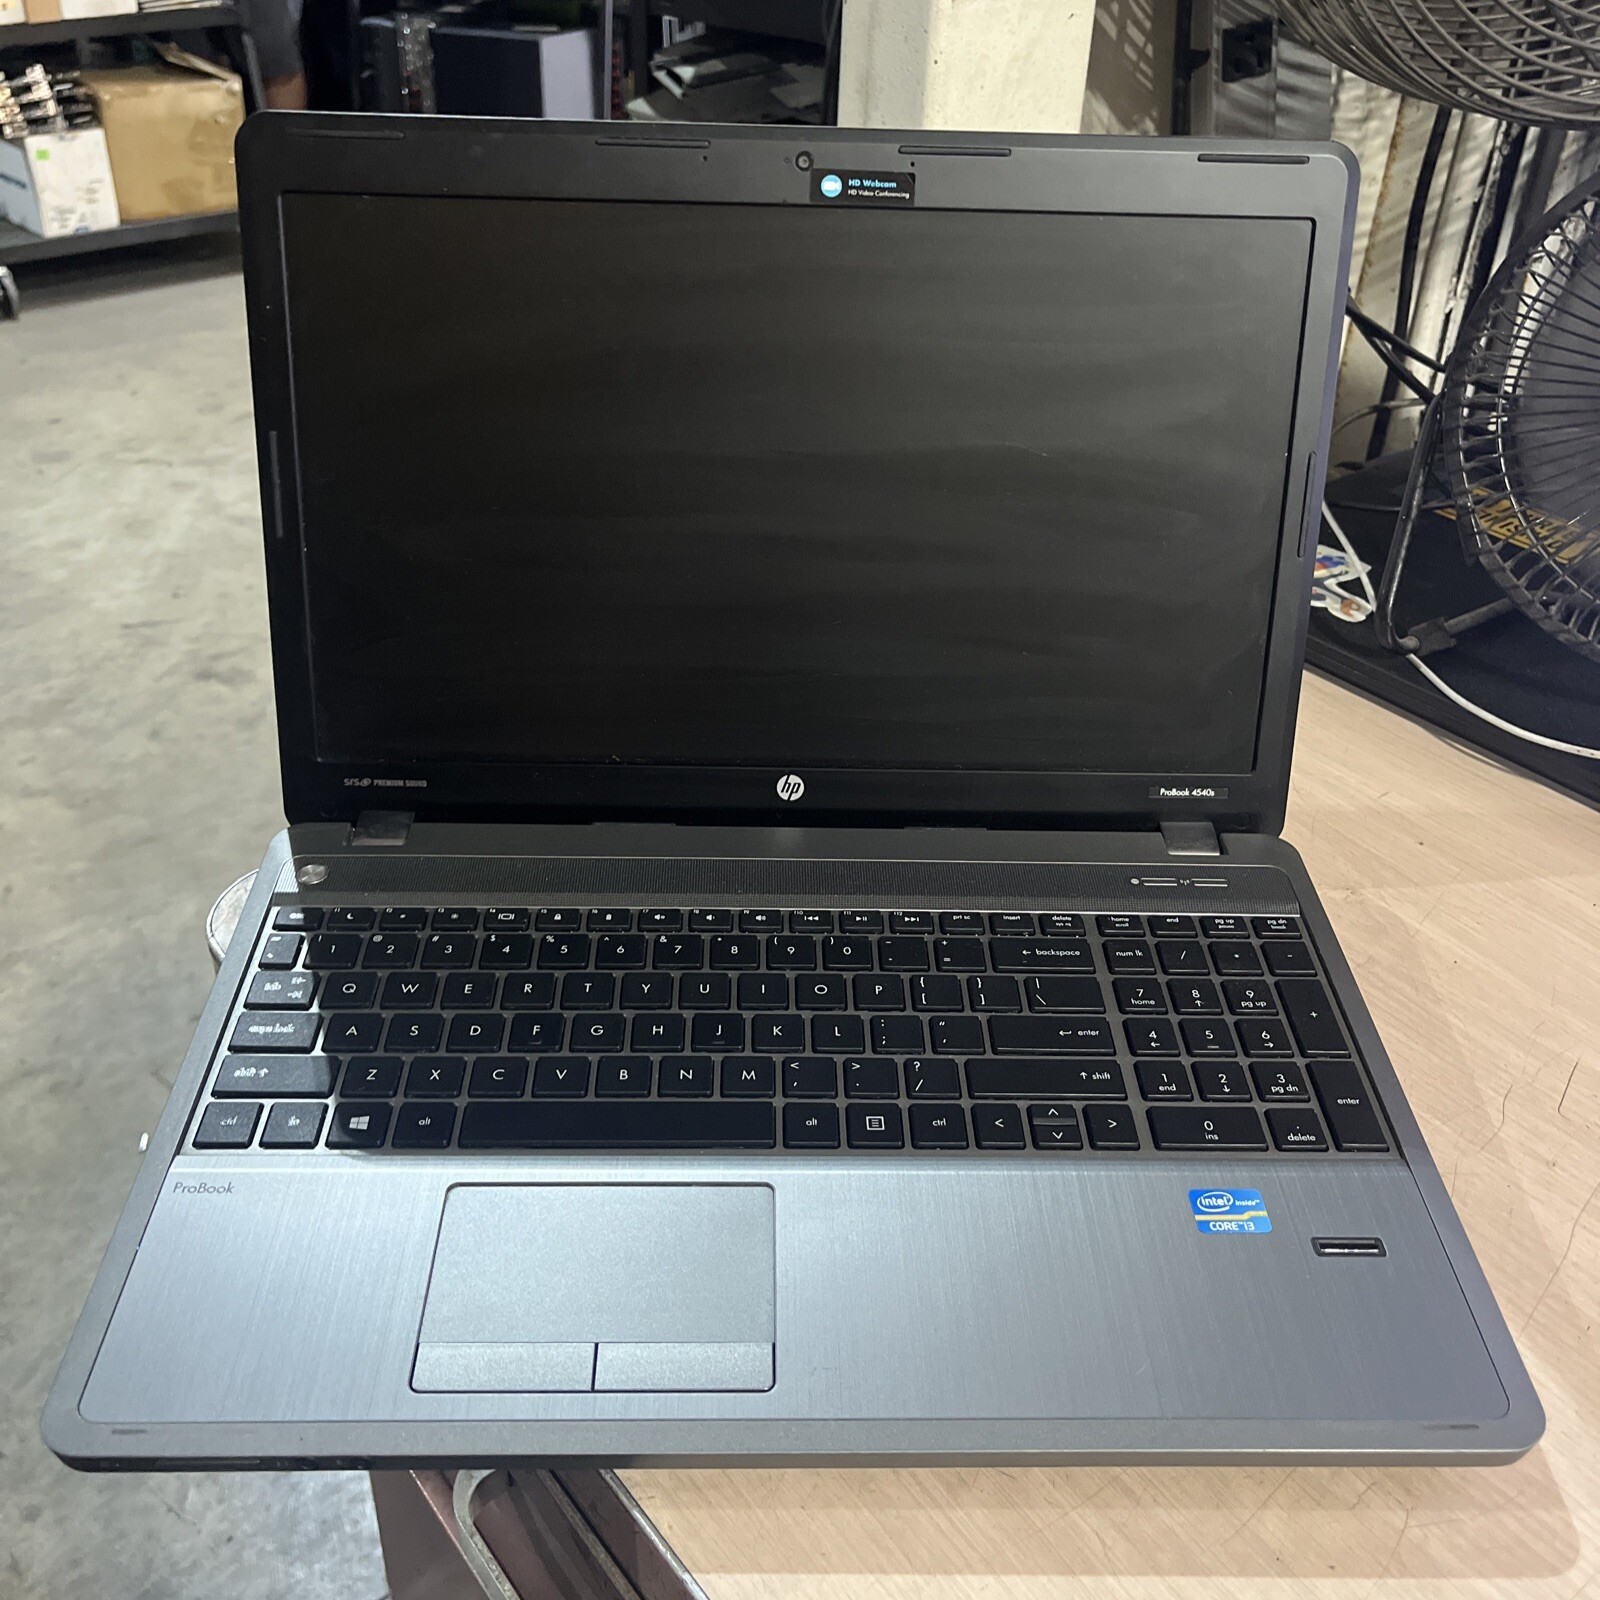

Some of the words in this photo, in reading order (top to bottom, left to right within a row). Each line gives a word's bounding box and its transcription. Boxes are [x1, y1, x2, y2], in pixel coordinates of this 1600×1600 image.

[848, 179, 860, 187] HD
[862, 179, 897, 188] Webcam
[875, 190, 910, 199] Conferencing
[779, 774, 803, 801] hp
[1160, 787, 1190, 796] ProBook
[1191, 788, 1215, 797] 4540s
[330, 945, 335, 953] 1
[386, 945, 394, 953] 2
[445, 945, 452, 953] 3
[561, 945, 567, 953] 5
[731, 946, 738, 954] 8
[1181, 951, 1186, 959] /
[919, 977, 924, 987] {
[976, 978, 981, 988] }
[1035, 978, 1040, 988] |
[343, 984, 356, 993] Q
[402, 984, 419, 993] W
[465, 984, 472, 993] E
[524, 984, 532, 993] R
[585, 983, 592, 992] T
[642, 984, 650, 993] Y
[700, 984, 709, 993] U
[761, 985, 765, 993] I
[815, 985, 827, 994] O
[876, 986, 882, 994] P
[1137, 989, 1143, 997] 7
[1192, 990, 1200, 998] 8
[1246, 990, 1254, 998] 9
[921, 994, 926, 1004] [
[980, 994, 985, 1004] ]
[1036, 995, 1046, 1005] \
[346, 1026, 357, 1035] A
[410, 1026, 418, 1035] S
[470, 1026, 481, 1035] D
[533, 1025, 540, 1035] F
[591, 1025, 603, 1035] G
[653, 1025, 663, 1035] H
[716, 1025, 721, 1035] J
[774, 1026, 782, 1035] K
[835, 1027, 840, 1036] L
[1206, 1031, 1213, 1039] 5
[1262, 1031, 1270, 1039] 6
[882, 1036, 886, 1044] ;
[914, 1061, 920, 1071] ?
[367, 1070, 377, 1080] Z
[430, 1070, 440, 1080] X
[493, 1069, 504, 1080] C
[556, 1070, 567, 1079] V
[620, 1070, 628, 1080] B
[680, 1070, 692, 1079] N
[742, 1070, 755, 1080] M
[1162, 1074, 1167, 1082] 1
[1219, 1074, 1227, 1083] 2
[1277, 1074, 1285, 1083] 3
[916, 1079, 923, 1091] /
[419, 1117, 430, 1125] alt
[933, 1118, 946, 1126] ctrl
[1204, 1121, 1213, 1130] 0
[1288, 1133, 1315, 1141] delete
[173, 1181, 234, 1194] ProBook
[1200, 1195, 1230, 1206] intel
